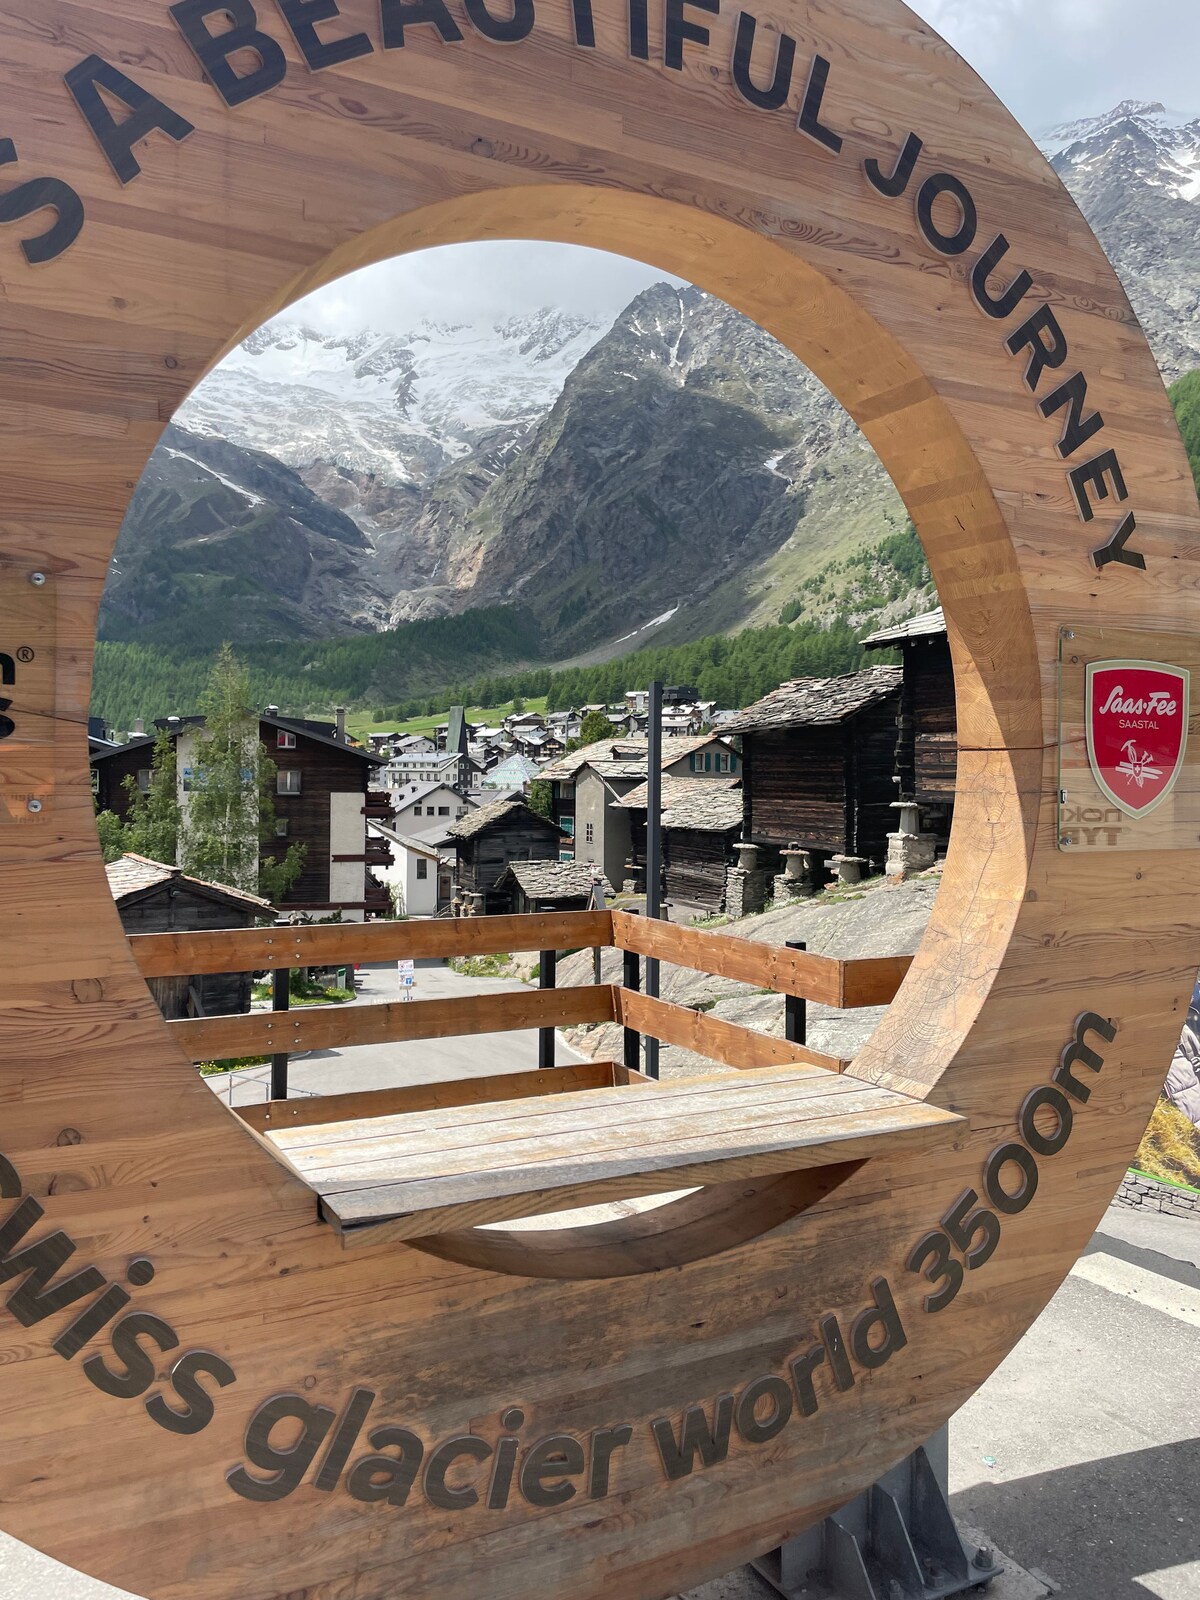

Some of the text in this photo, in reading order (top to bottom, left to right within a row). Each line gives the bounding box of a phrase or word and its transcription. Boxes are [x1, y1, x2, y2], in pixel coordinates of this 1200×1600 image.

[63, 53, 196, 187] A
[862, 131, 1147, 571] JOURNEY
[1119, 719, 1160, 730] SAASTAL
[226, 1386, 633, 1510] glacier
[650, 1276, 907, 1480] world
[905, 1010, 1118, 1313] 3500m
